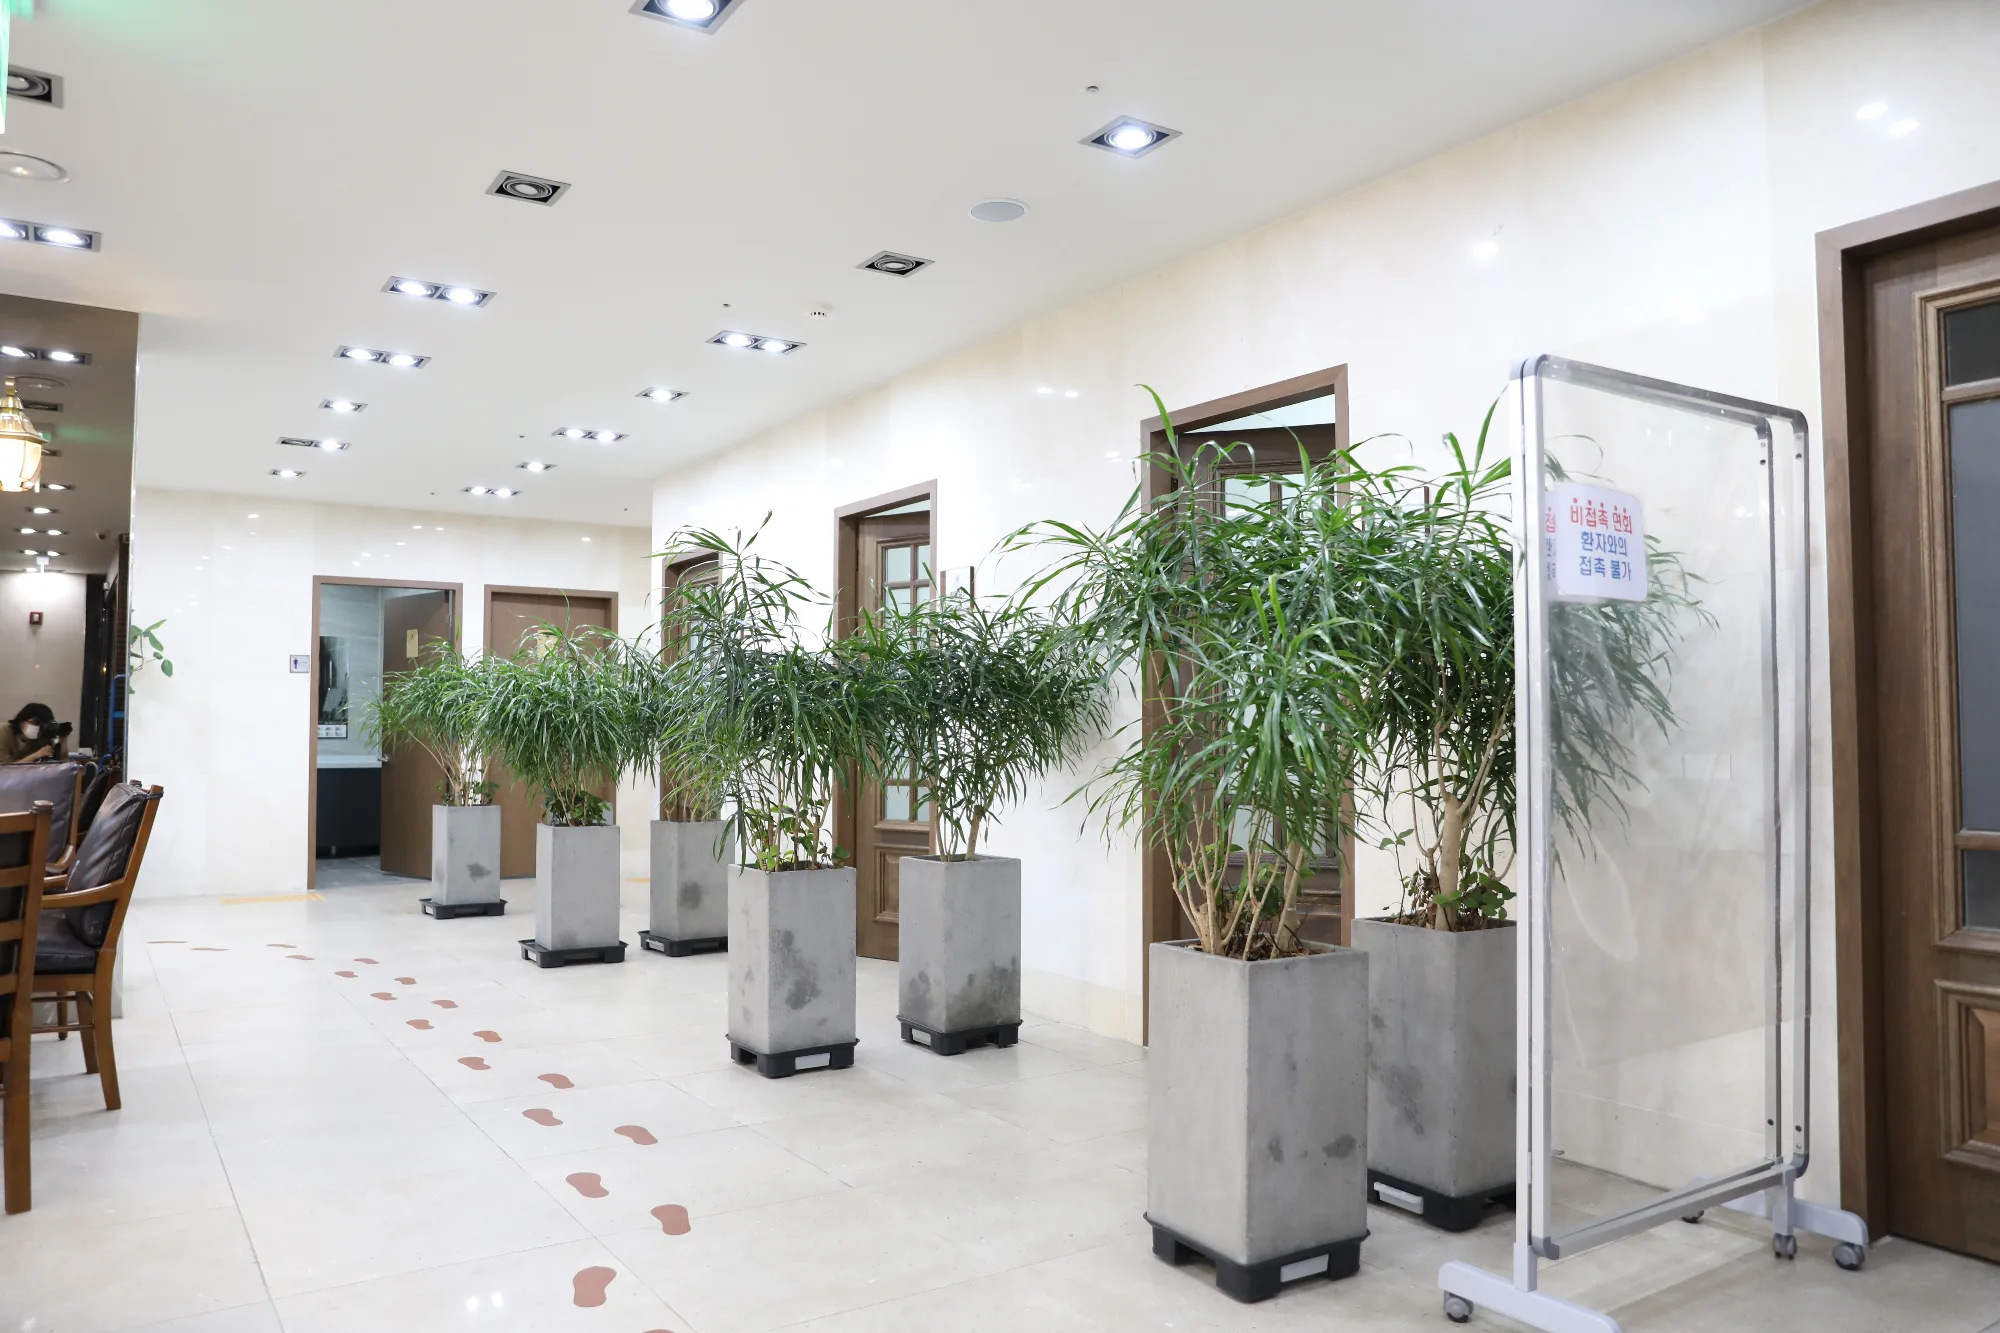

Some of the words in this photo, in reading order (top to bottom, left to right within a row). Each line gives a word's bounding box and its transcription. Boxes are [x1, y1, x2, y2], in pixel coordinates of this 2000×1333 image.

[1570, 503, 1609, 530] 비접촉
[1612, 510, 1633, 534] 면회
[1580, 531, 1628, 557] 환자와의
[1579, 555, 1606, 578] 접촉
[1610, 559, 1632, 581] 불가
